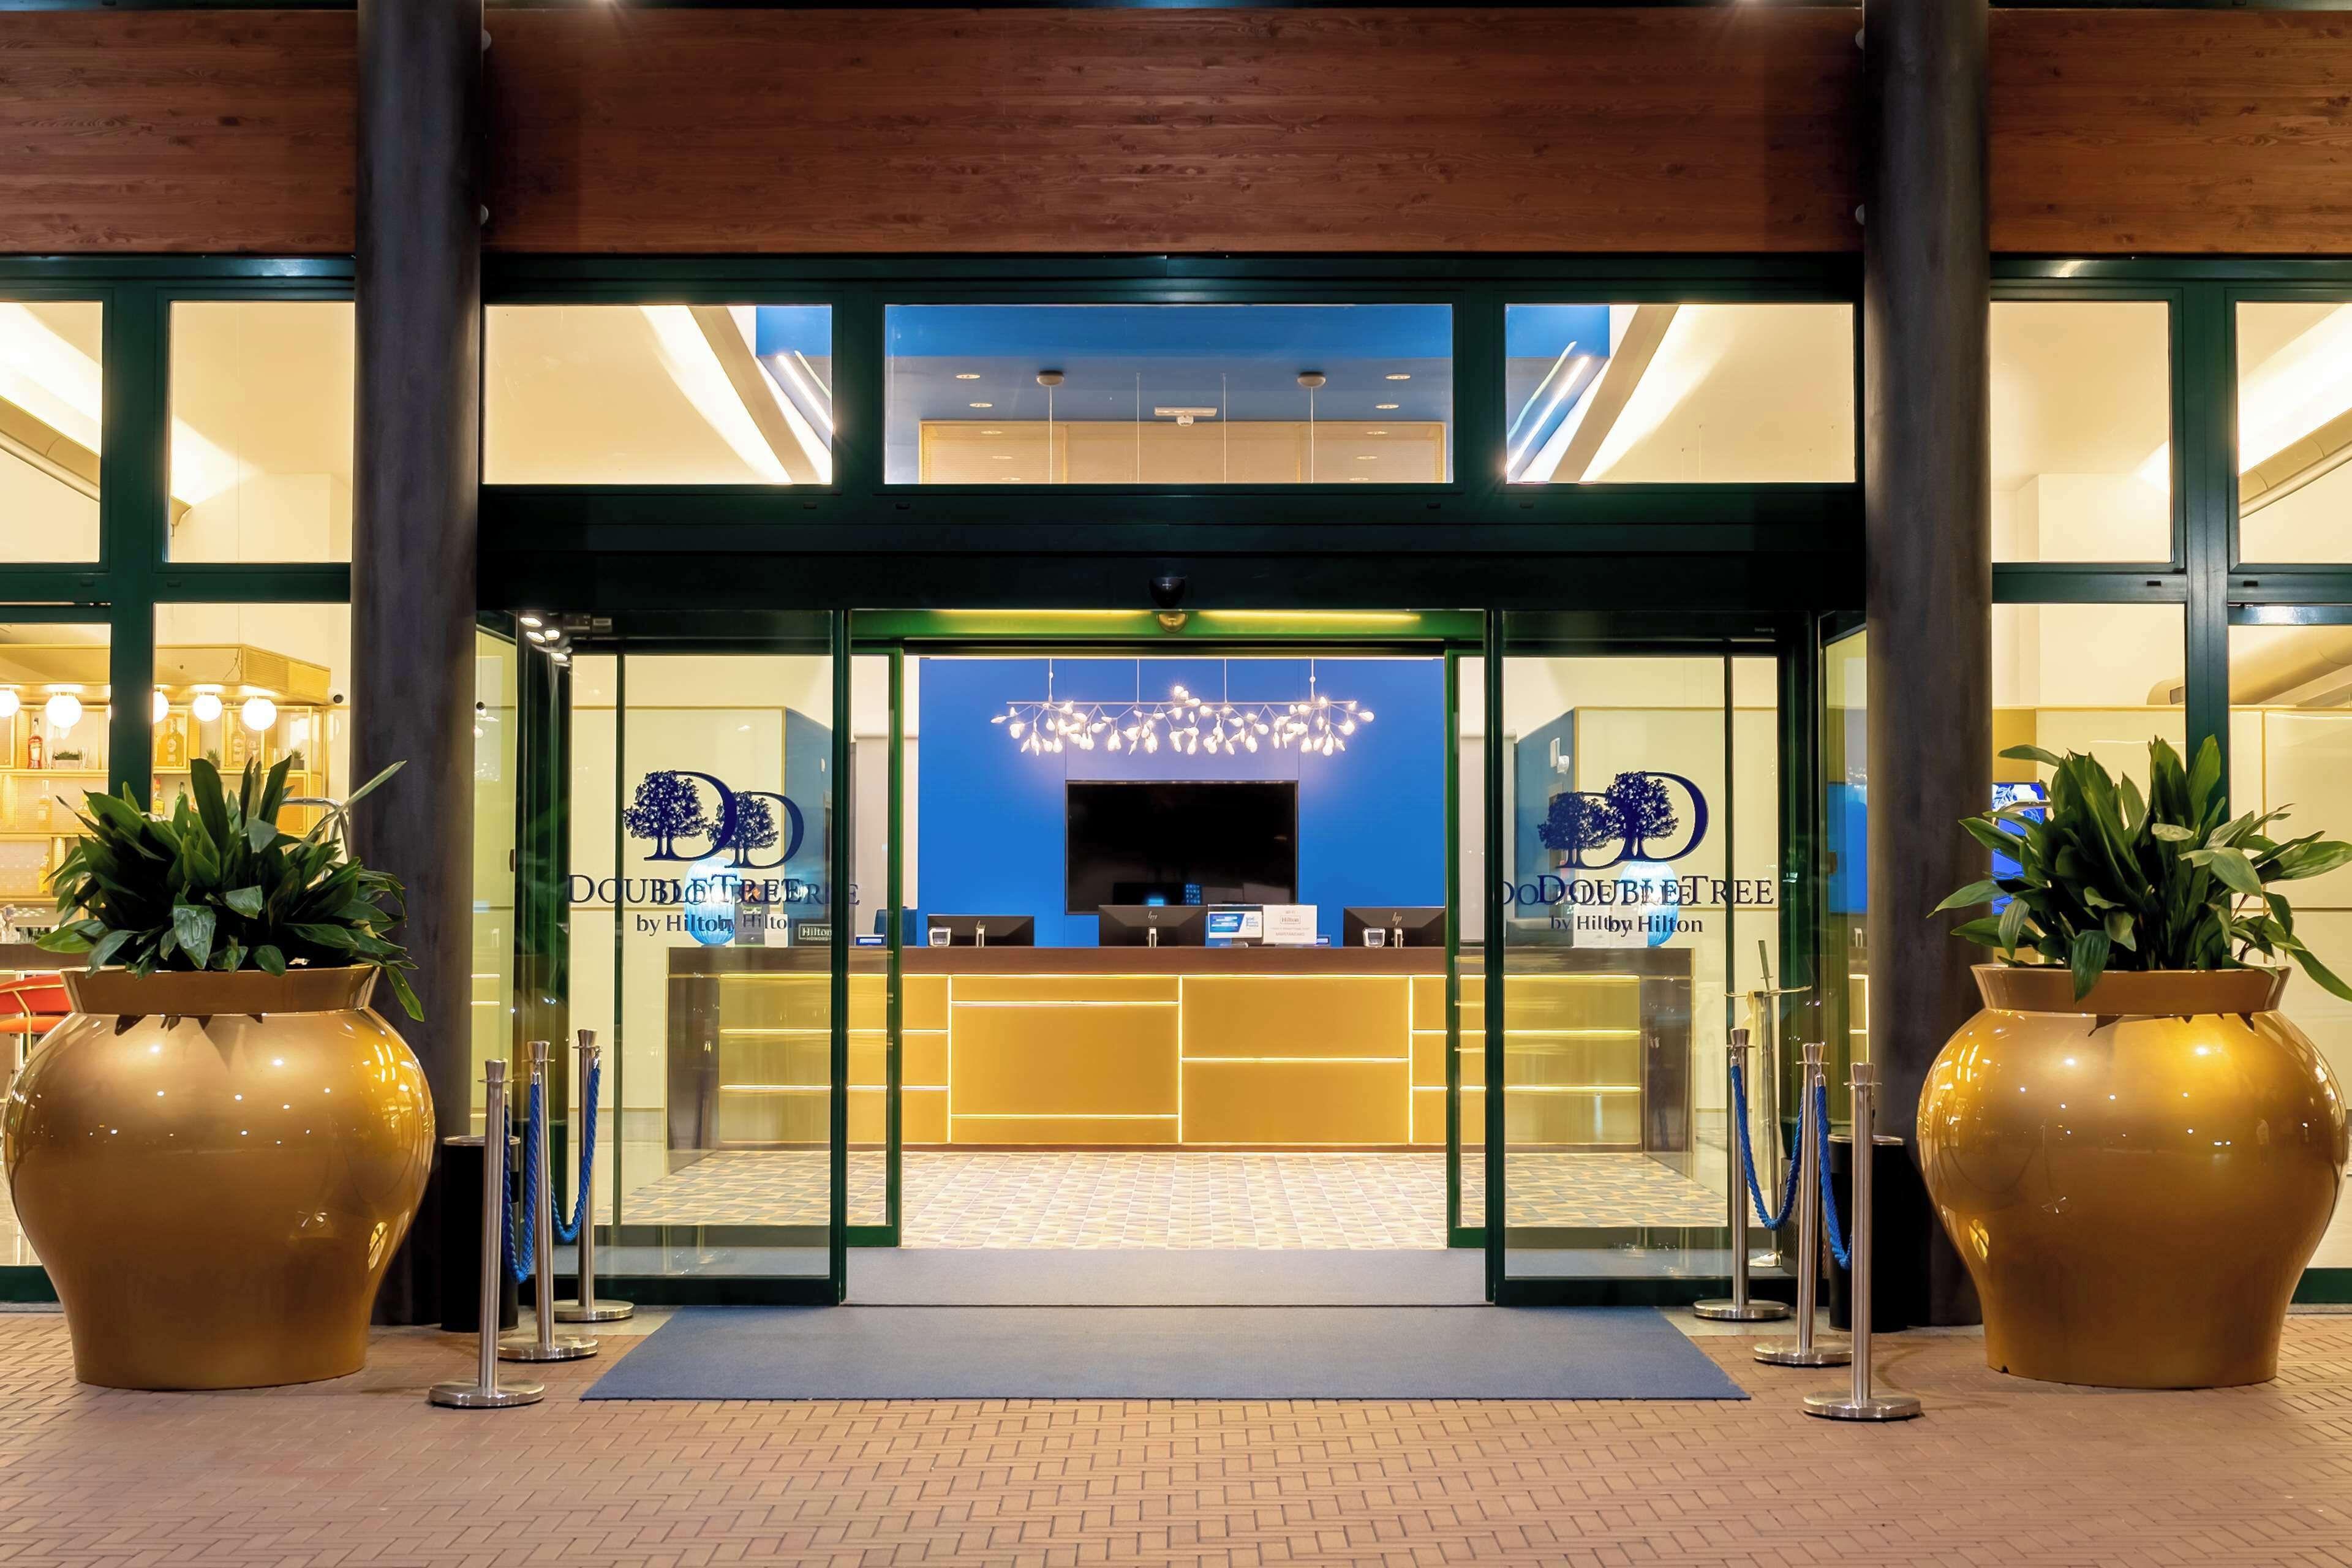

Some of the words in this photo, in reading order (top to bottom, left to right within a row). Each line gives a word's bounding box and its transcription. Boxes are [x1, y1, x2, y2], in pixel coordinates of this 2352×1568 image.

[636, 914, 660, 936] by
[666, 914, 732, 932] Hilton
[802, 927, 832, 937] Hilton
[1608, 915, 1632, 937] by
[1638, 914, 1703, 932] Hilton
